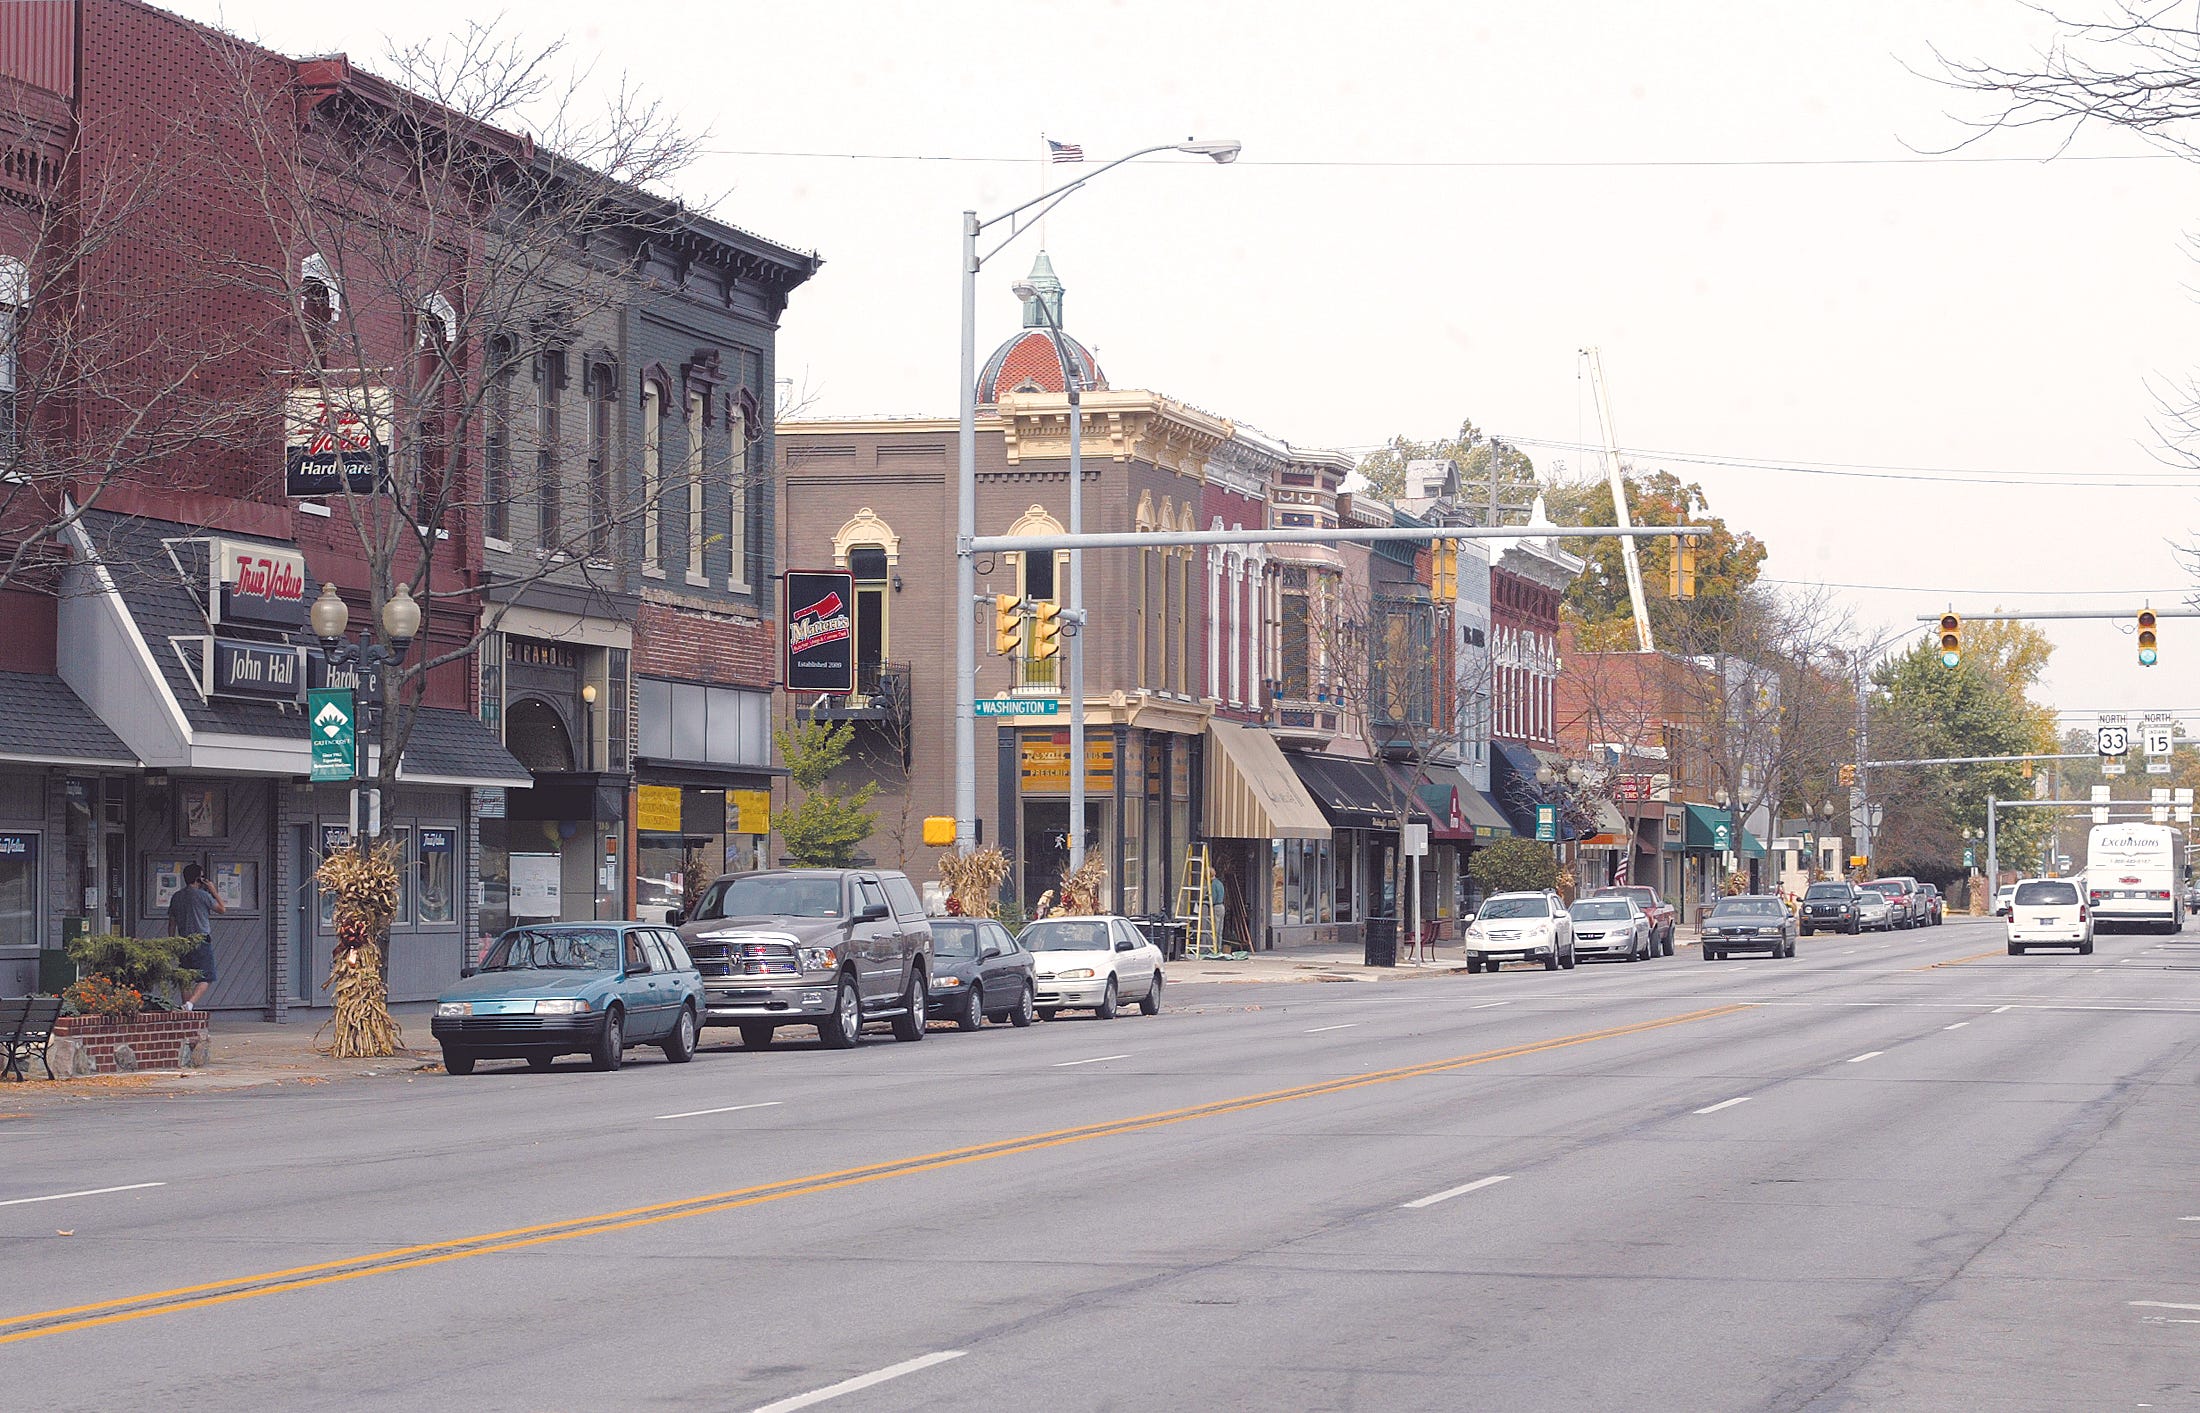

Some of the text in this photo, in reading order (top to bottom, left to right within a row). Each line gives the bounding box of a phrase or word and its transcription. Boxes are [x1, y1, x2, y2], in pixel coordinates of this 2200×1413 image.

[233, 556, 303, 602] True Value
[230, 650, 294, 685] John Hall
[326, 663, 377, 692] Hardwe
[982, 701, 1044, 714] WASHINGTON
[2099, 714, 2126, 724] NORTH
[2144, 713, 2171, 722] NORTH
[2102, 733, 2124, 749] 33
[2150, 736, 2168, 752] 15
